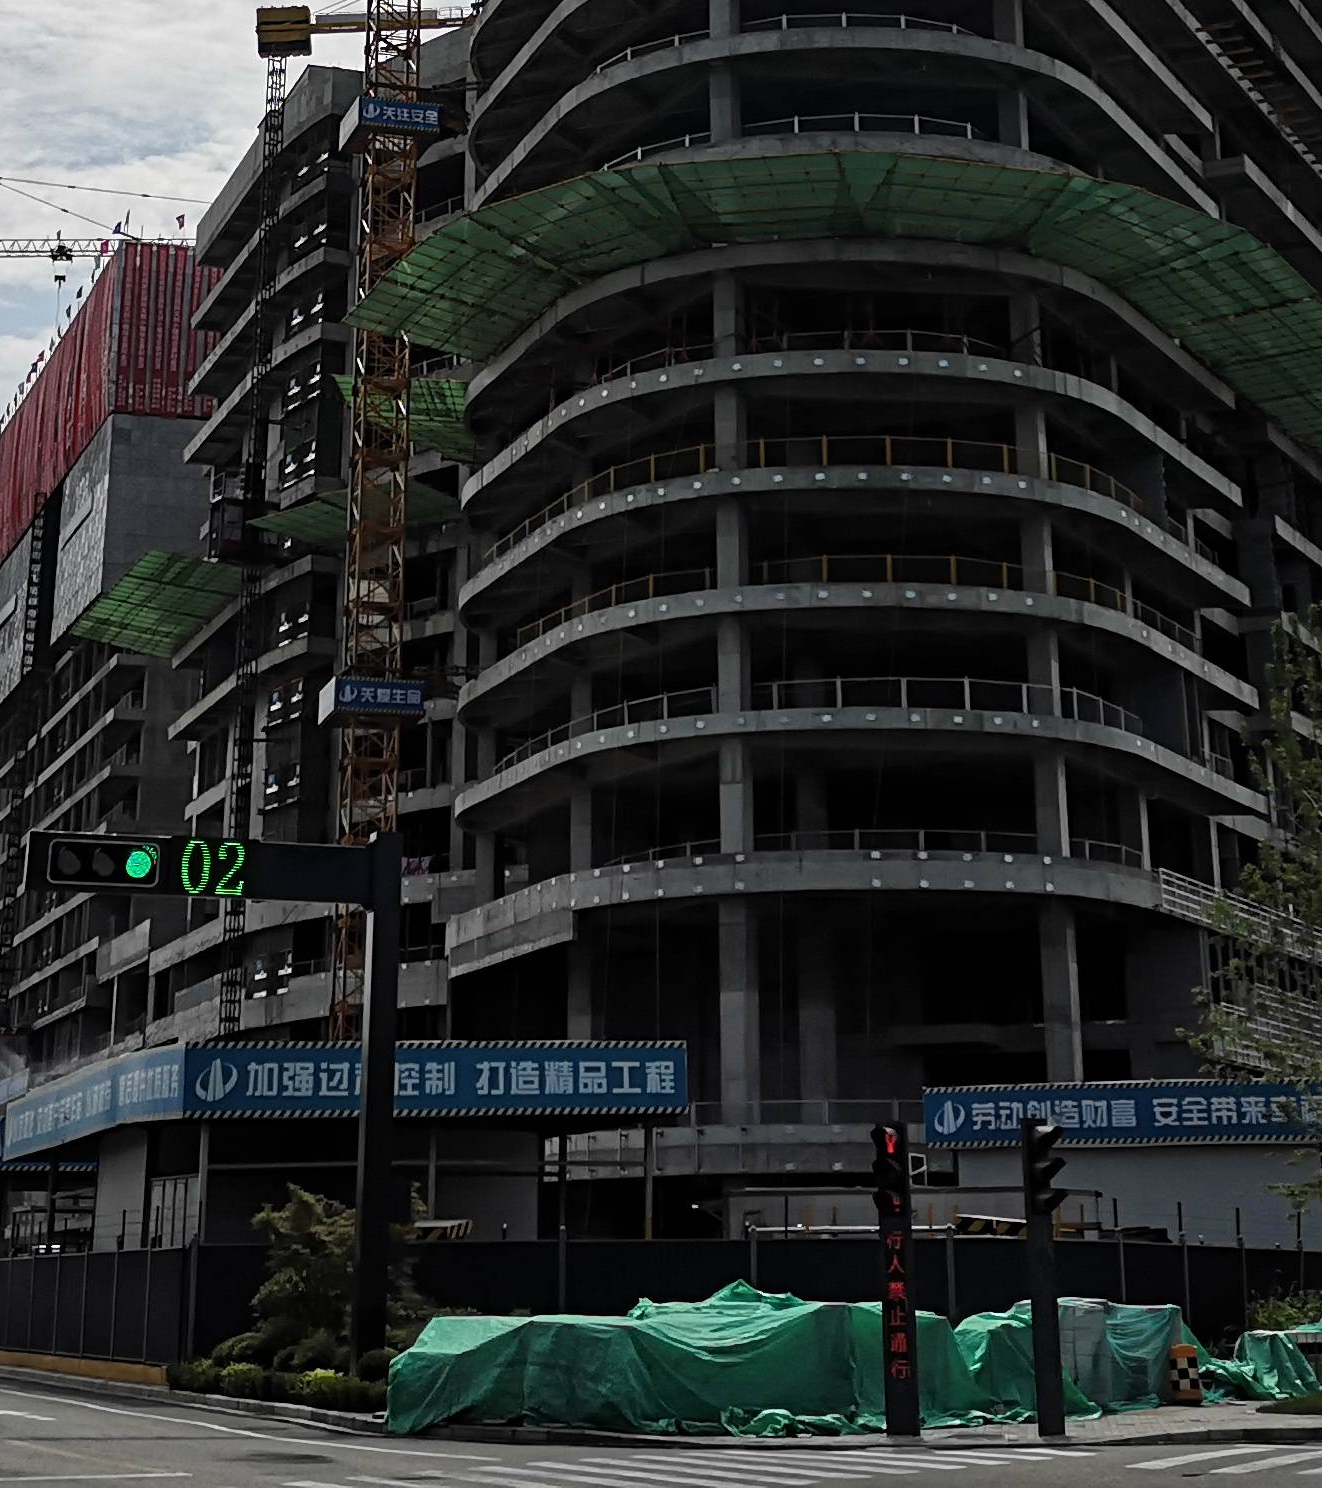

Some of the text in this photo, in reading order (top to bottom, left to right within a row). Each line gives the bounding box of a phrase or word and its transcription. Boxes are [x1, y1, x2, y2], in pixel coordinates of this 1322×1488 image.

[180, 840, 246, 896] 02
[245, 1060, 676, 1098] 加强过控制 打造精品工程
[885, 1231, 912, 1381] 行人禁止通行
